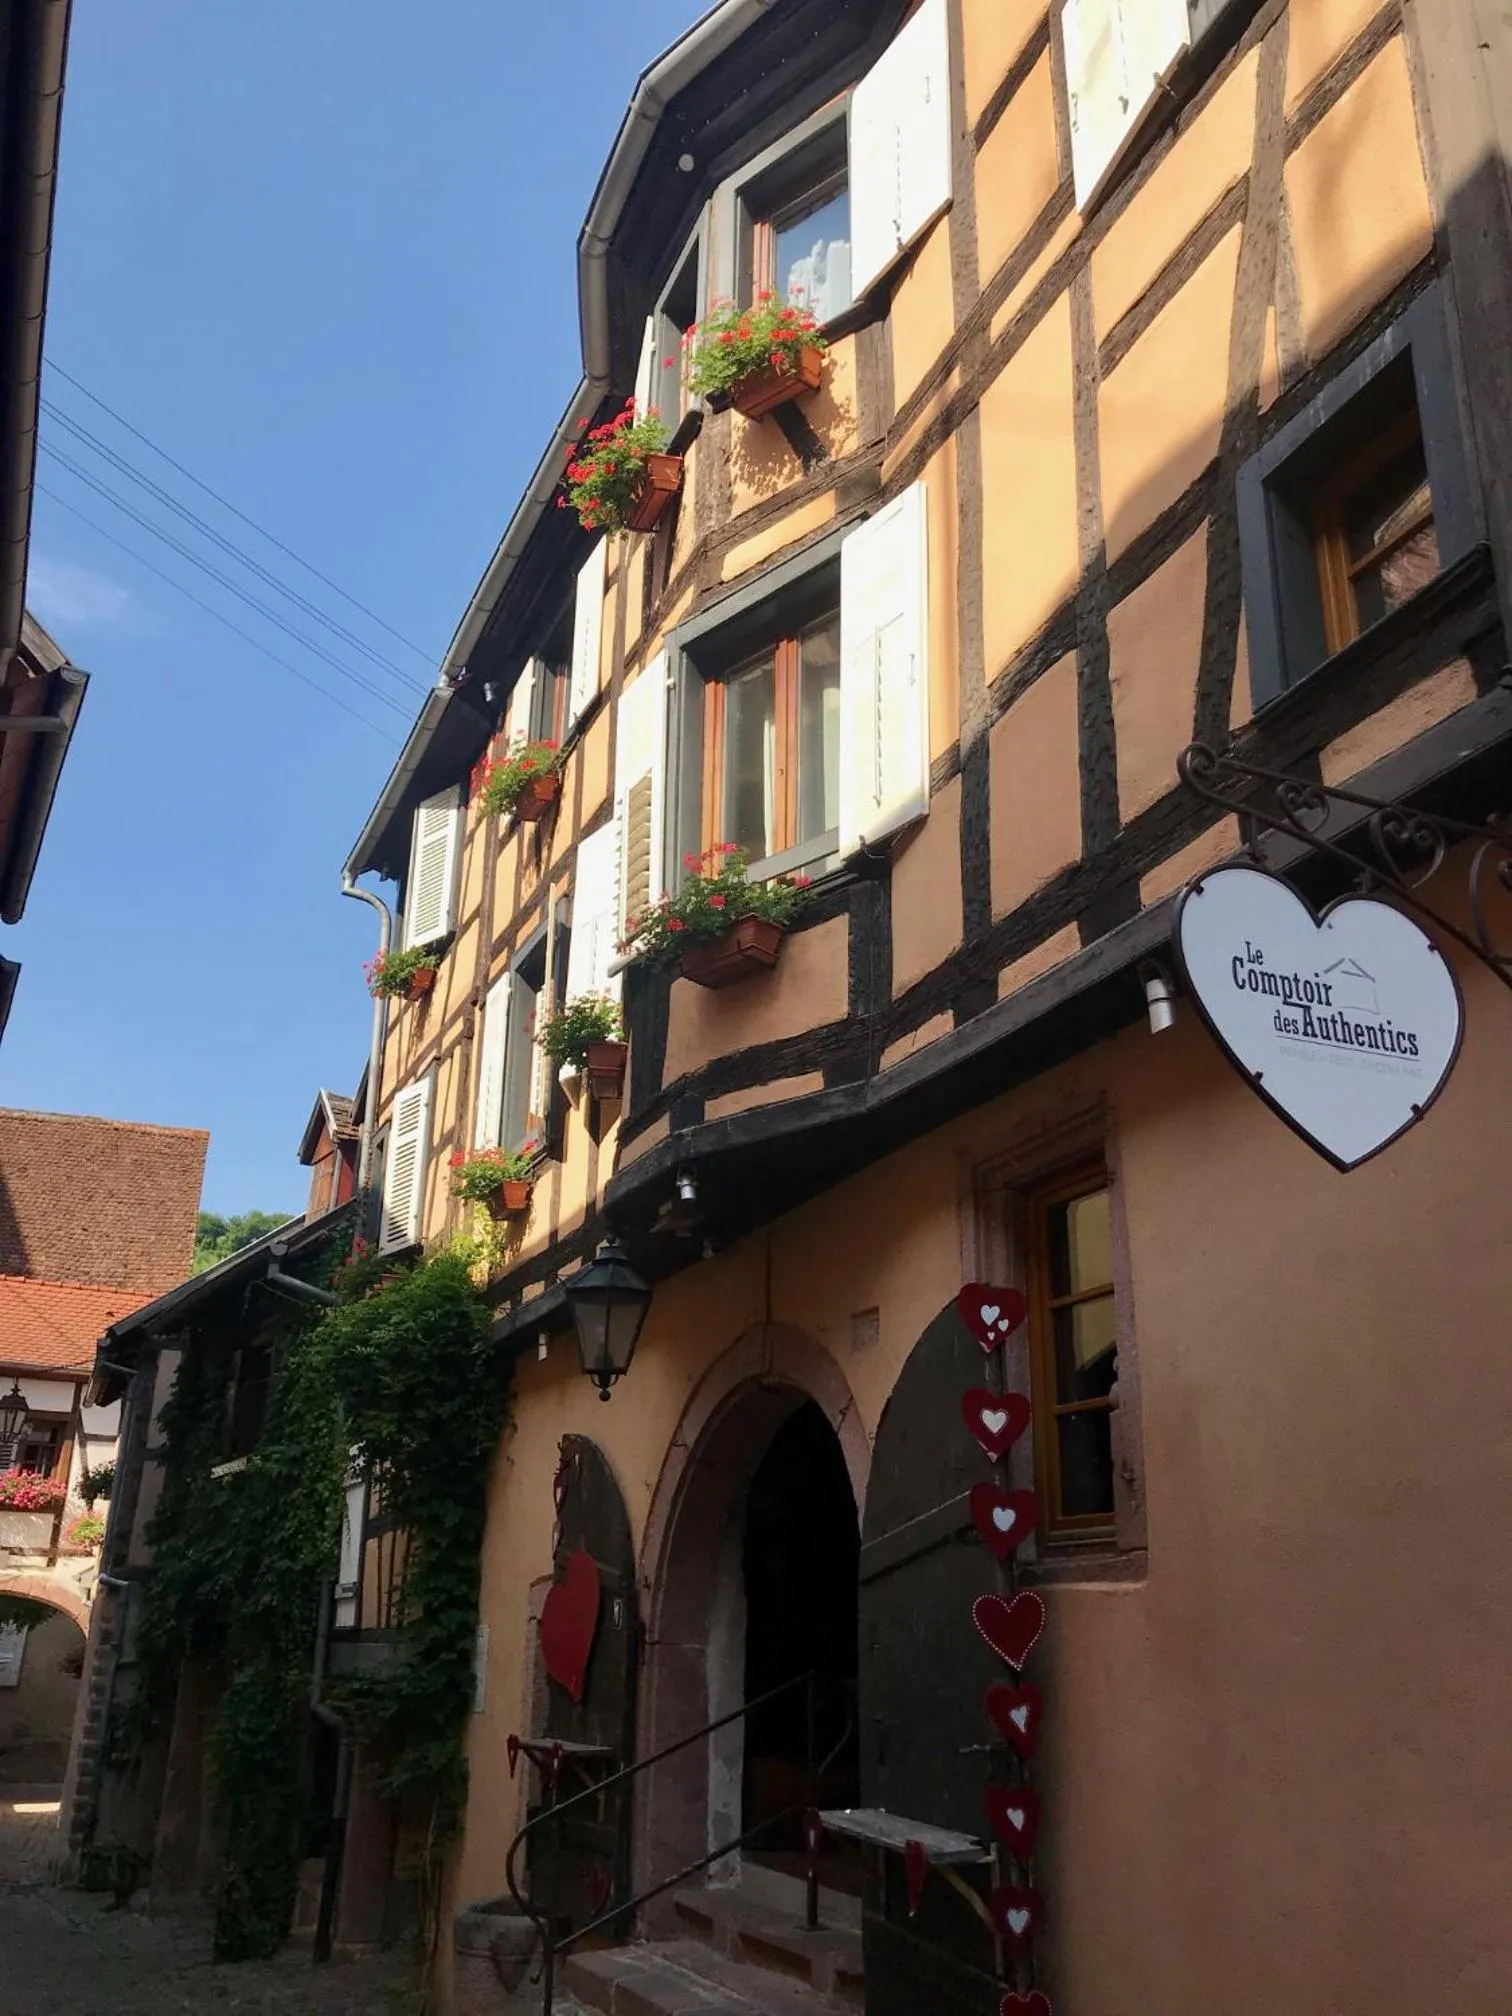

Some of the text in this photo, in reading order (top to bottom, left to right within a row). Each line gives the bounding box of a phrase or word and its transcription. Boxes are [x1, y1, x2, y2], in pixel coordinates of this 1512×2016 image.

[1245, 941, 1264, 966] Le
[1231, 956, 1333, 1007] Comptoir
[1273, 1004, 1420, 1057] des Authentics
